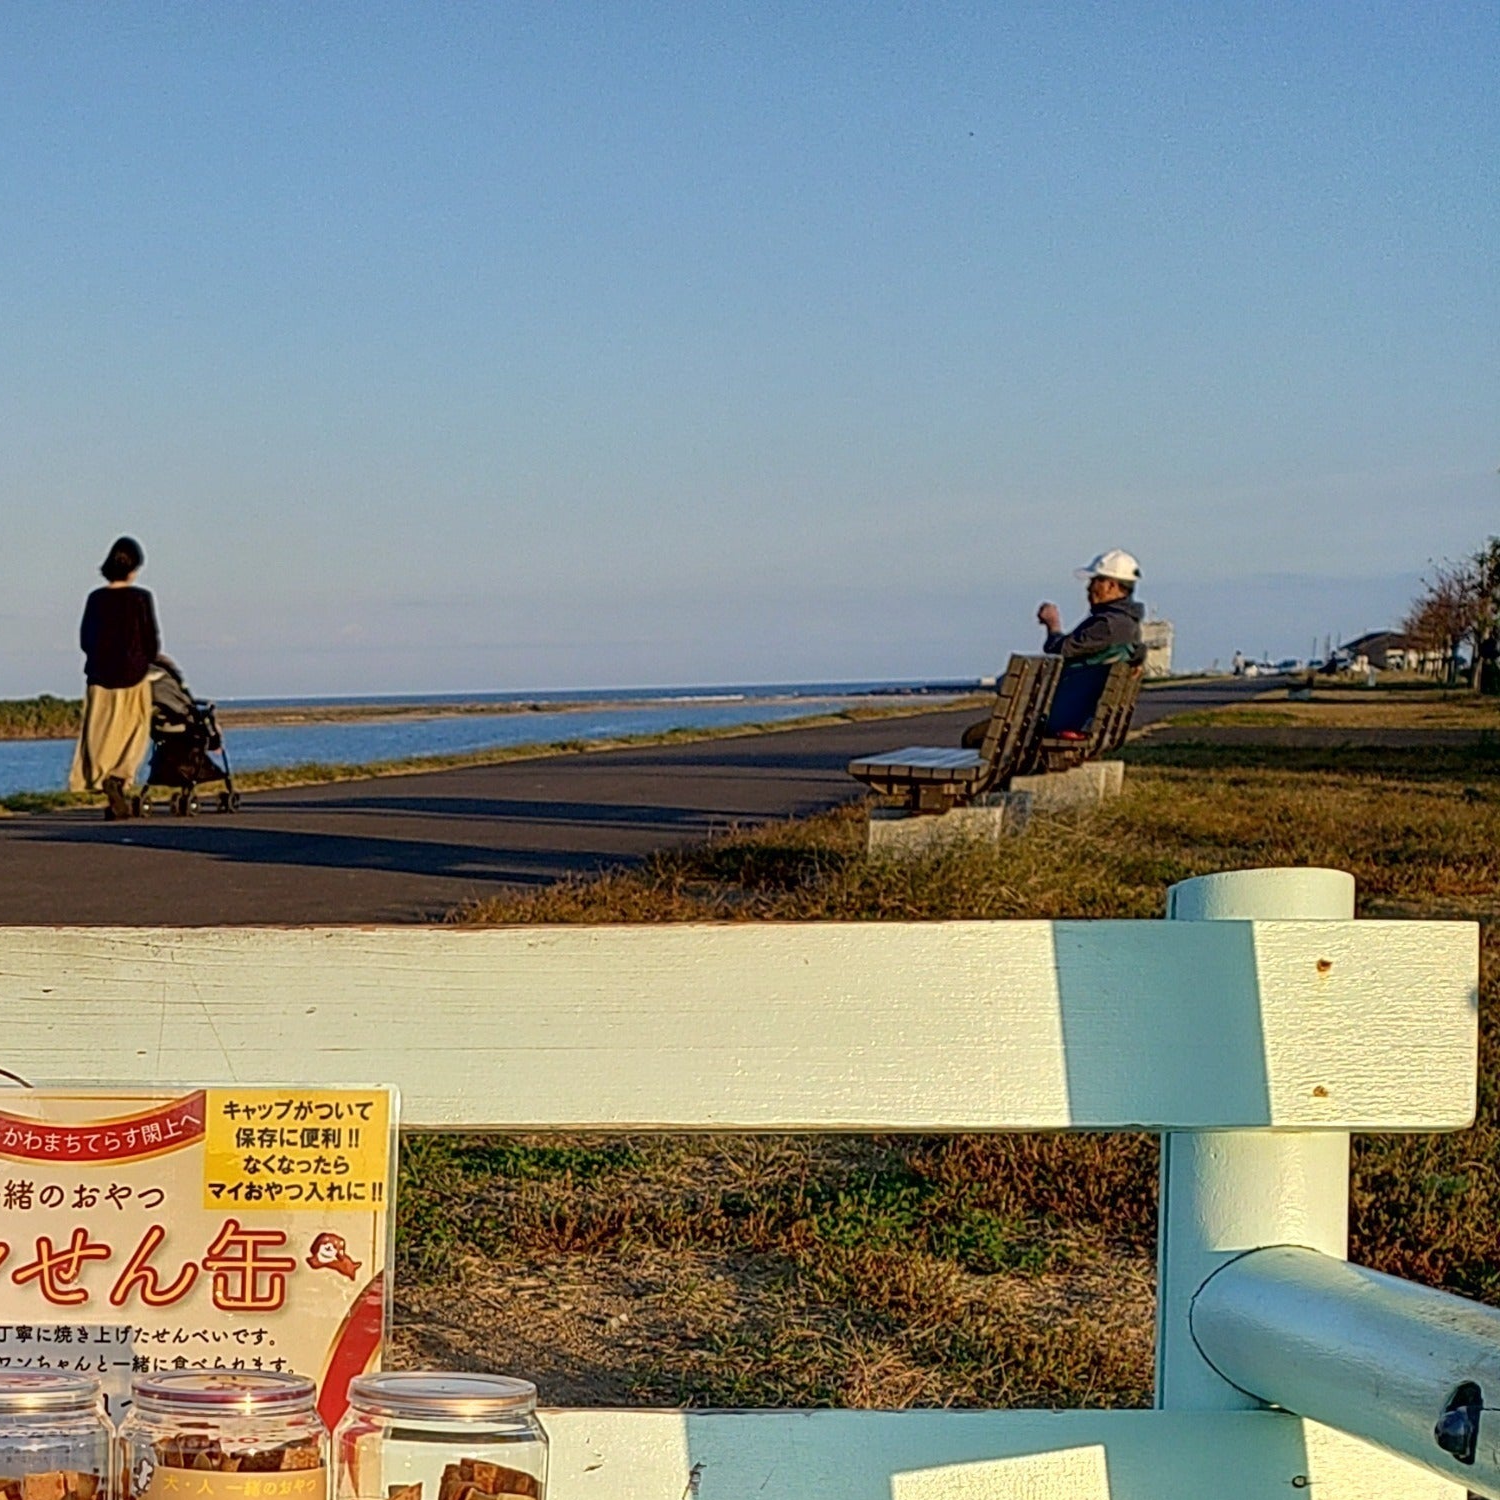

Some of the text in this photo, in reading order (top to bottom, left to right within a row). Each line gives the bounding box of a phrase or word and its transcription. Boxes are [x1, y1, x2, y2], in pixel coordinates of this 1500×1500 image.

[223, 1100, 373, 1120] キャップがついて
[243, 1155, 349, 1174] なくなったら
